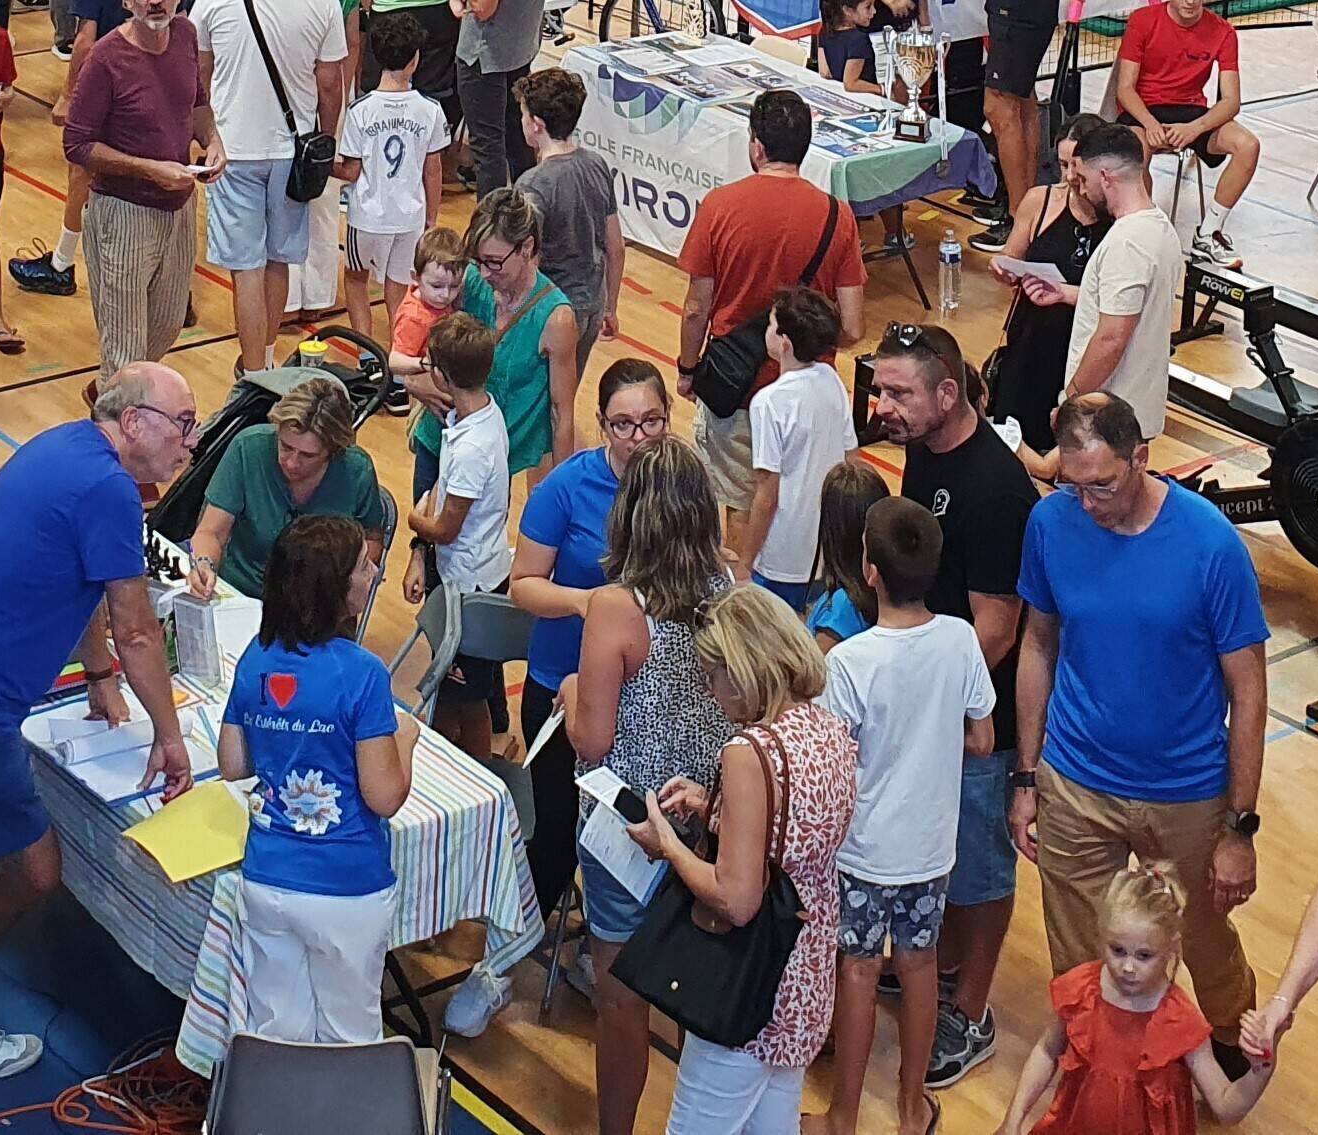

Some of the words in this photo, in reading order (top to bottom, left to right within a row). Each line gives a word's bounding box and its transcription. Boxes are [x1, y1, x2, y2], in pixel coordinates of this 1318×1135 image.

[383, 134, 405, 179] 9
[622, 144, 724, 190] FRANÇAISE
[260, 672, 268, 706] I
[292, 719, 305, 733] du
[308, 719, 335, 734] Lac
